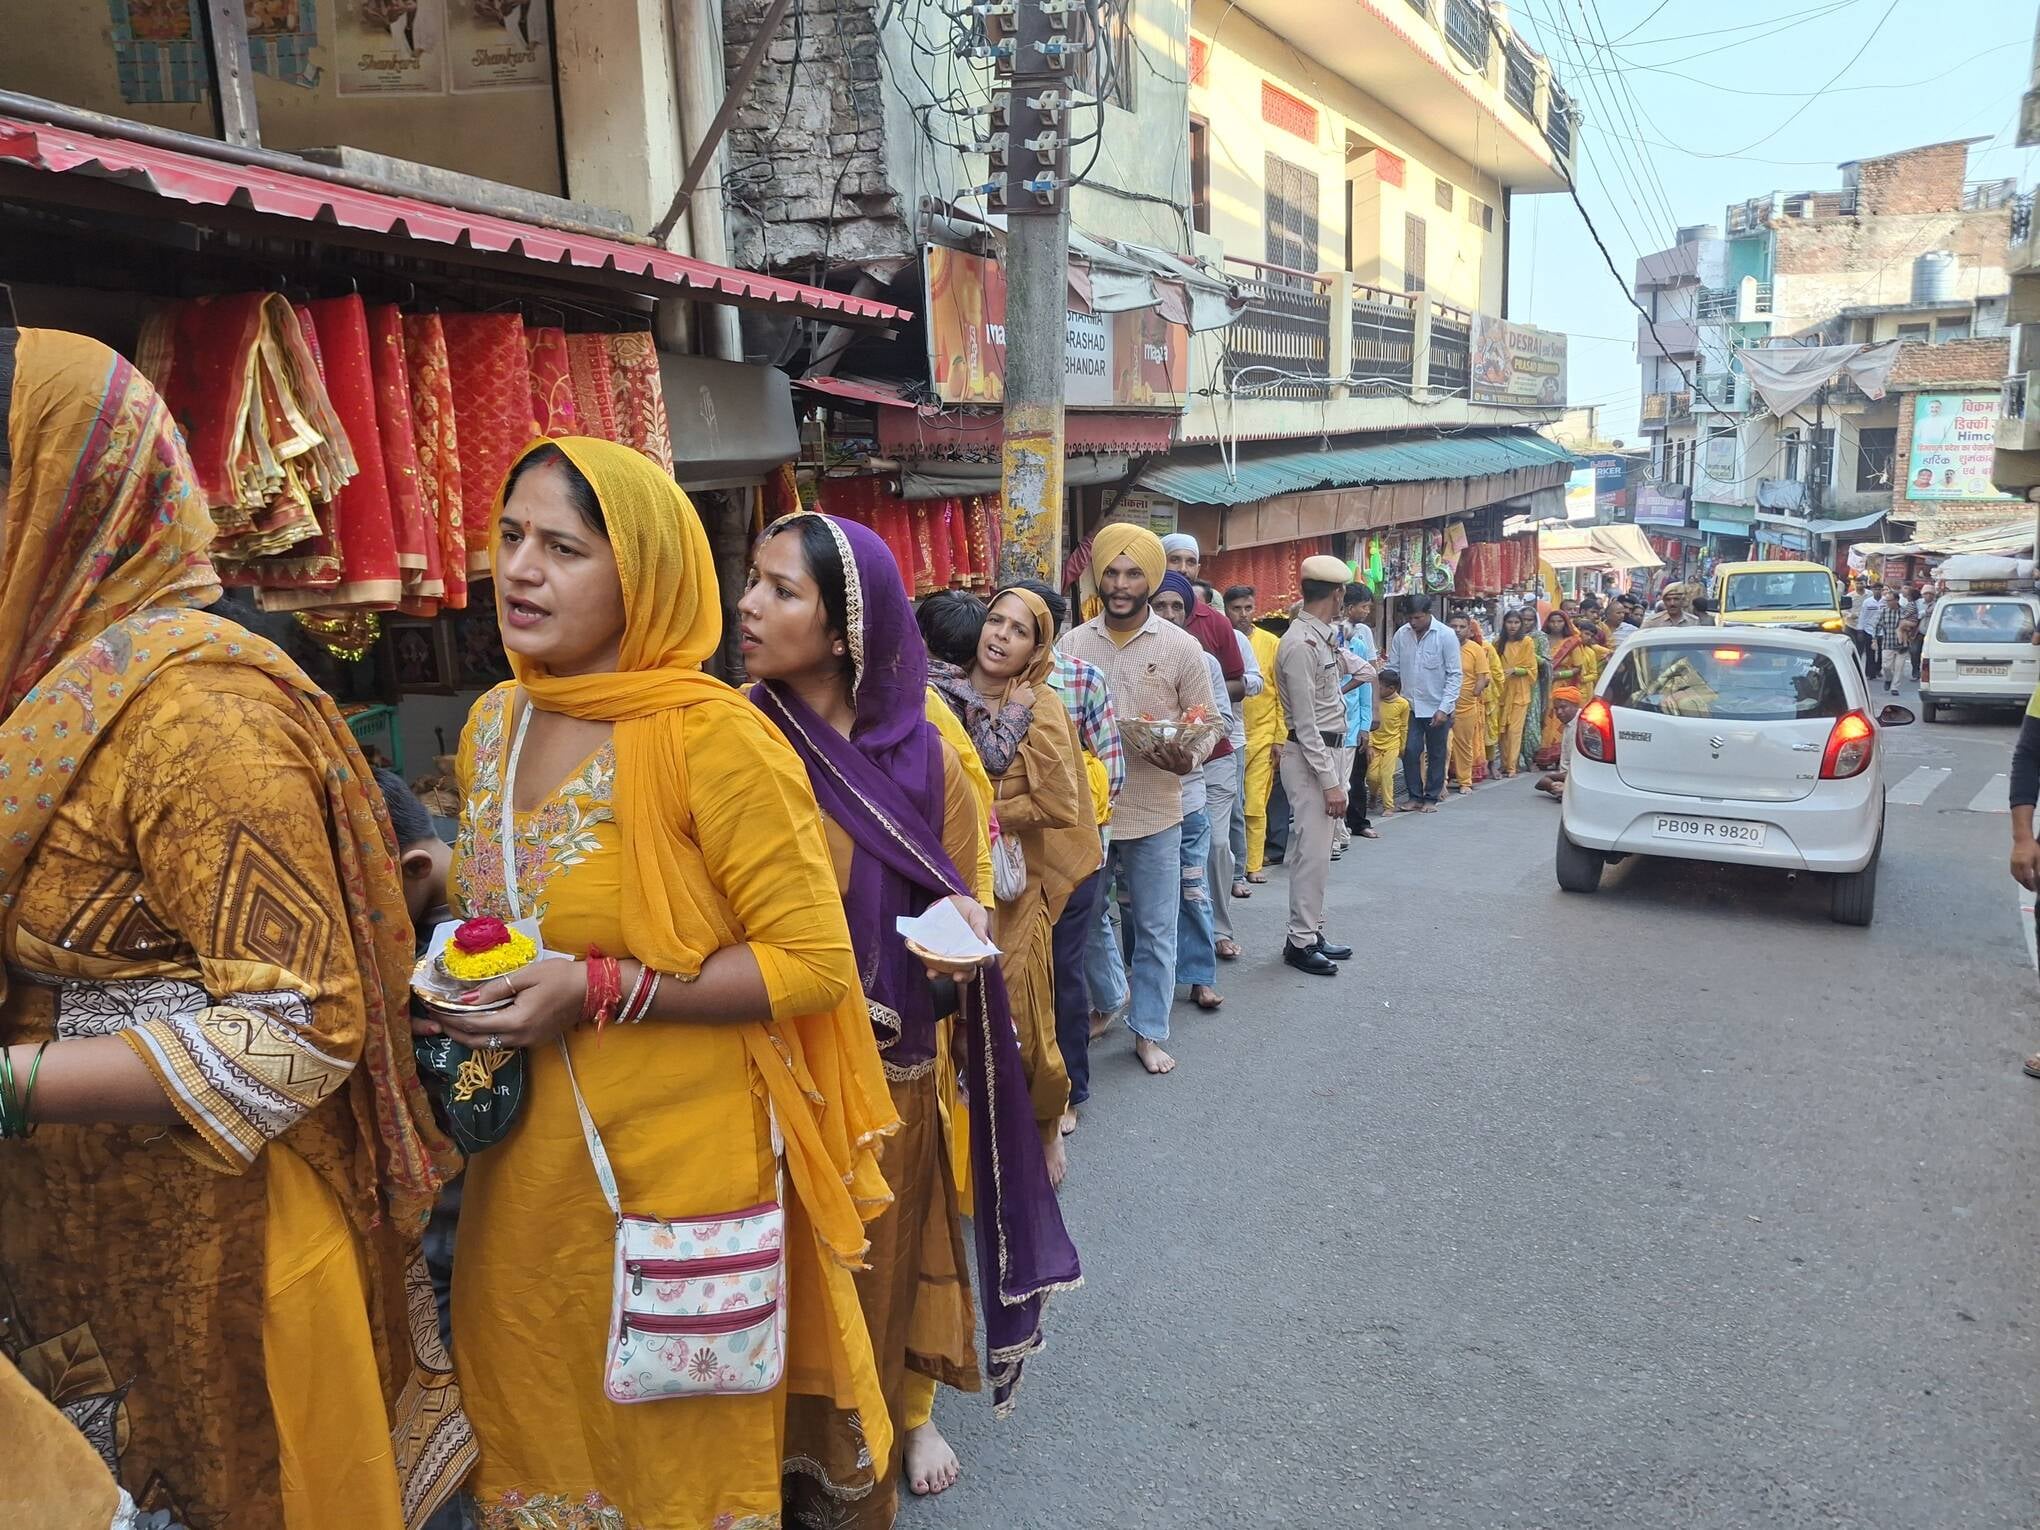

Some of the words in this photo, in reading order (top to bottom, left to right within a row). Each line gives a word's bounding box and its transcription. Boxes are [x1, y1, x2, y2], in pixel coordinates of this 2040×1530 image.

[986, 323, 1006, 345] ma
[1597, 467, 1621, 475] RKER
[1658, 819, 1699, 834] PB09
[1704, 823, 1715, 836] R
[1720, 825, 1759, 841] 9820
[492, 1085, 511, 1096] UR
